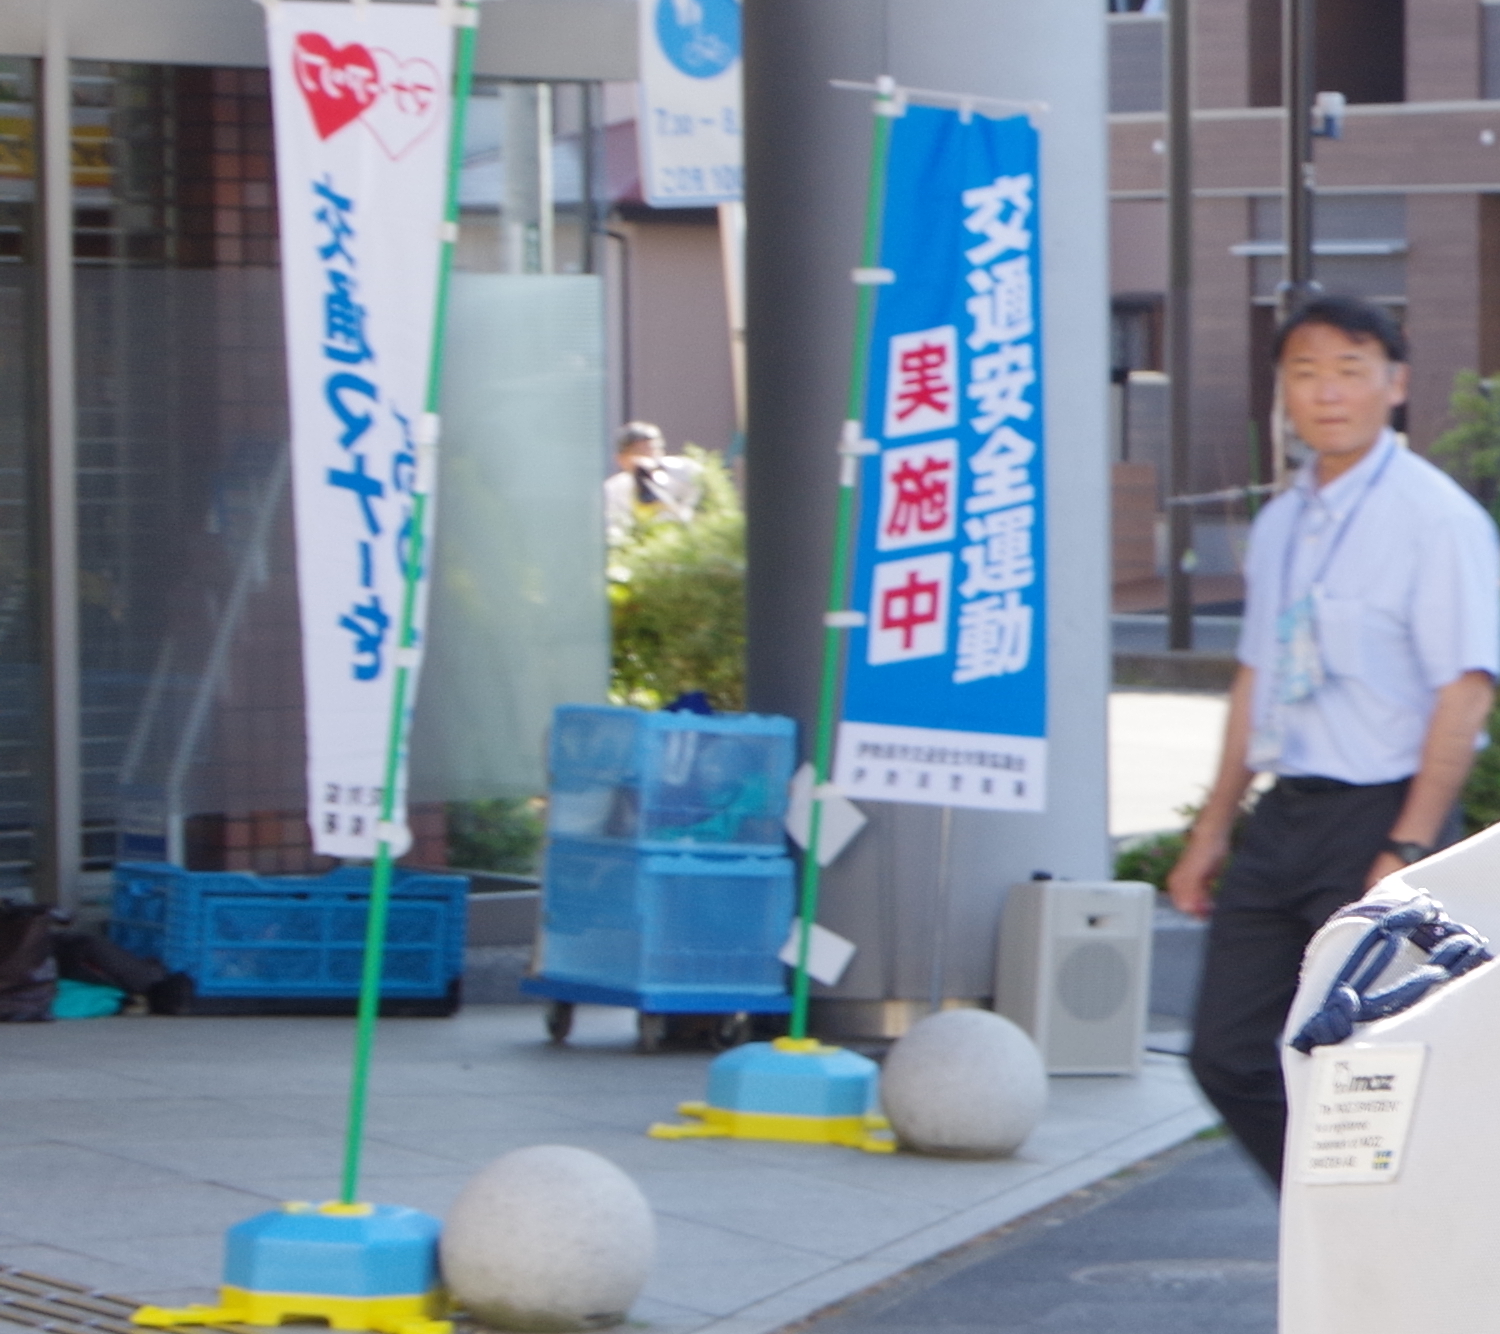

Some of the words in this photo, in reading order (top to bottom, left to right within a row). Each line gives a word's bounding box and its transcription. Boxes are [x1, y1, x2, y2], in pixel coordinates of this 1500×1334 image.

[879, 340, 952, 651] 実施中
[952, 173, 1036, 684] 交通安全運動
